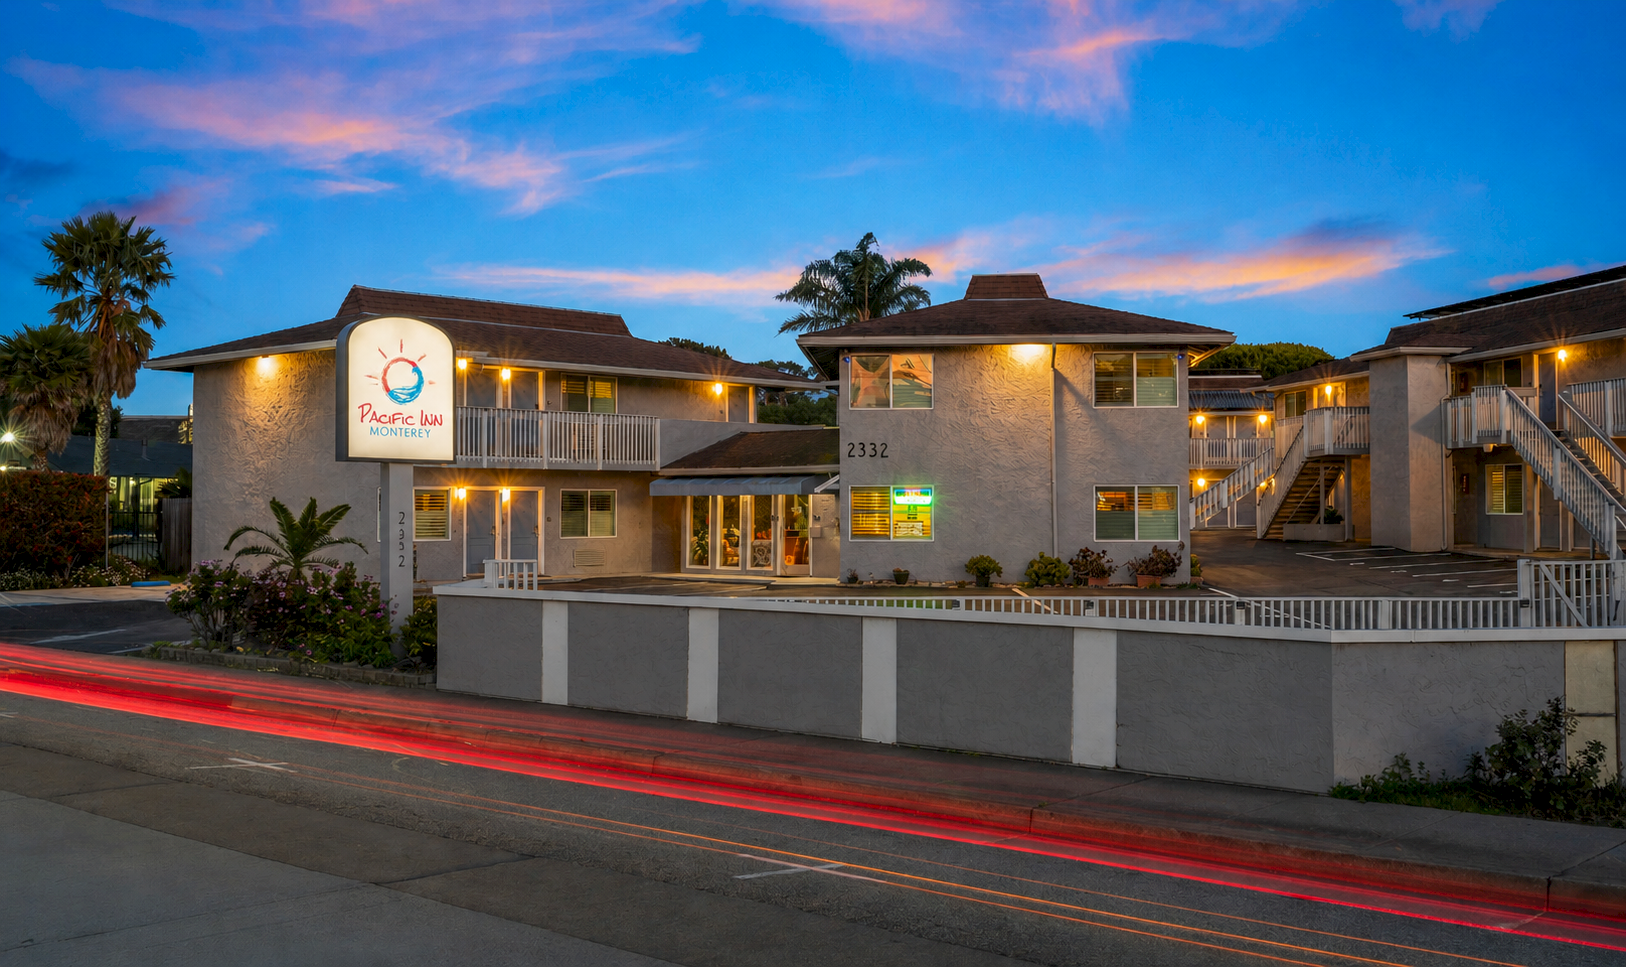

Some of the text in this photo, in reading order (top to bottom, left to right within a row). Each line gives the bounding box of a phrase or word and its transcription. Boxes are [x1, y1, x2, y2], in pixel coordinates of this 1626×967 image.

[420, 409, 443, 426] INN
[369, 426, 431, 438] MONTEREY
[847, 442, 889, 458] 2332
